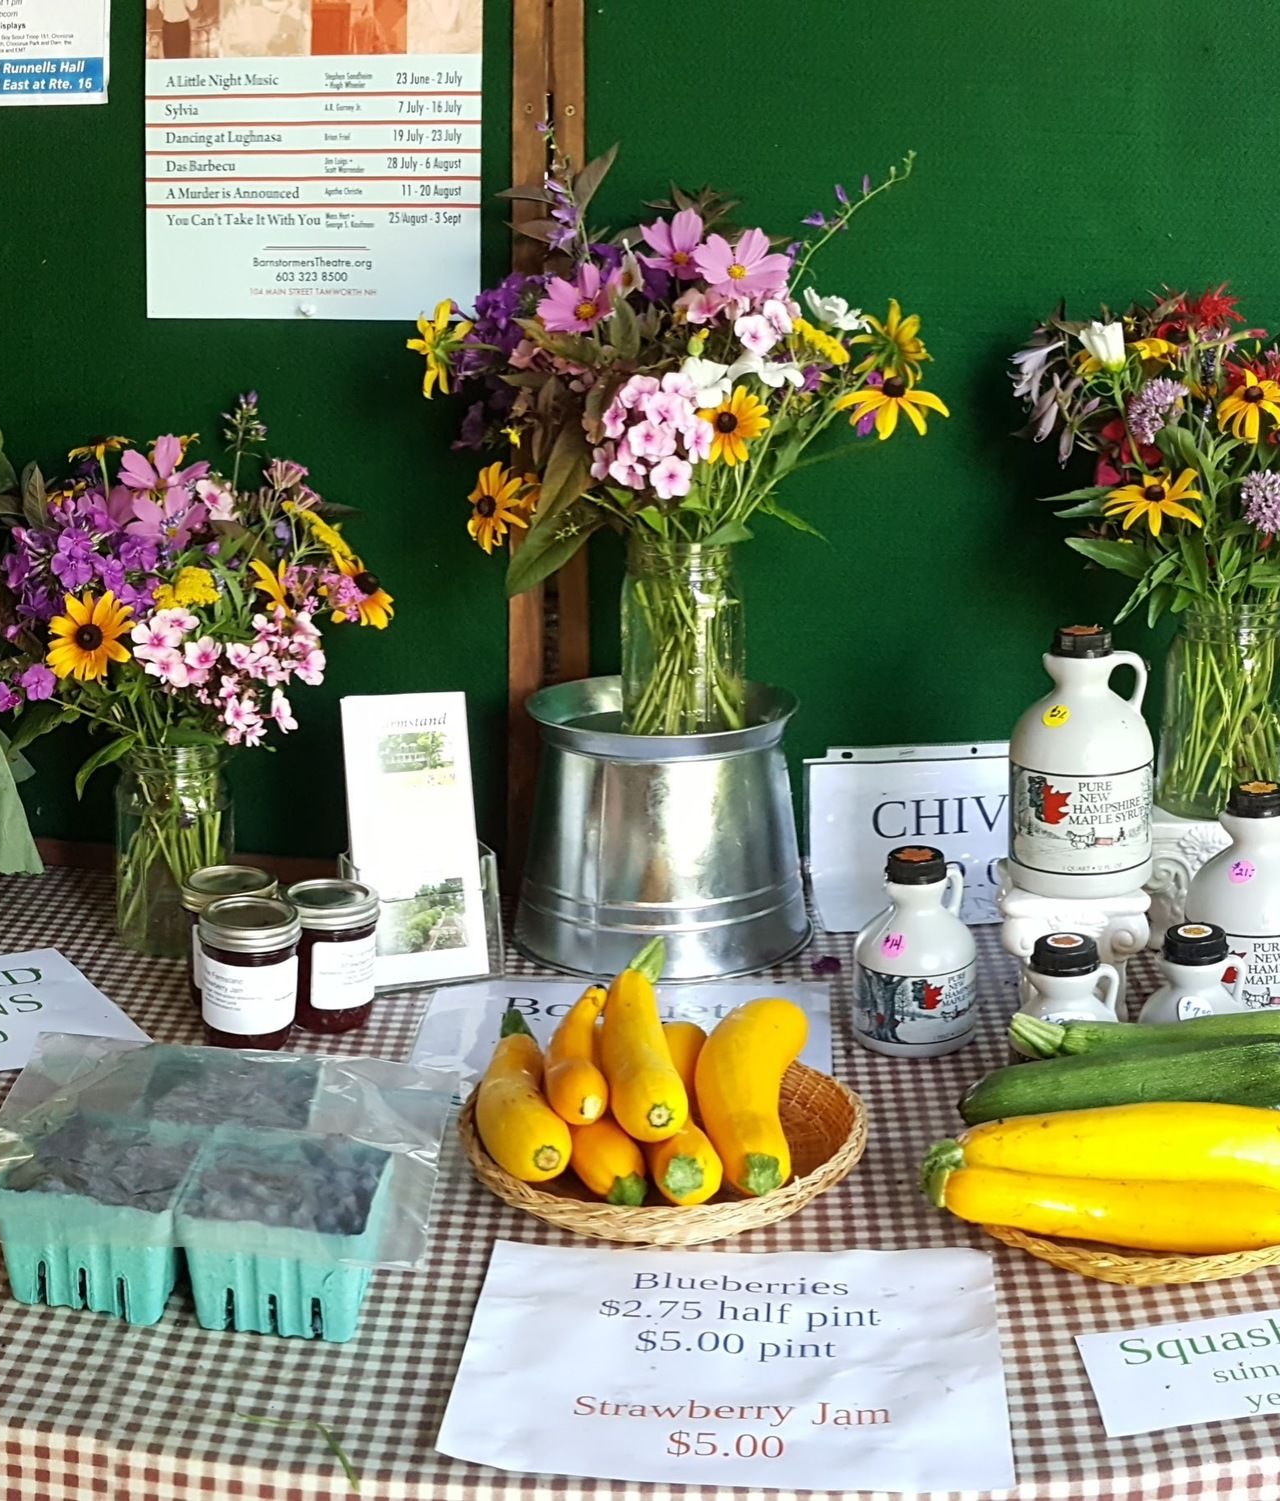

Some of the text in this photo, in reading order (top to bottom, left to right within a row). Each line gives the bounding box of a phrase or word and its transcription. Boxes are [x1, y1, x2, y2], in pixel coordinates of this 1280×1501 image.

[3, 61, 57, 74] Runnells
[60, 61, 86, 73] Hall
[3, 79, 30, 91] East
[49, 78, 73, 90] Rte.
[208, 74, 280, 90] Night Music
[165, 104, 199, 118] Sylvia
[165, 131, 283, 147] Dancing Lughnasa
[166, 160, 189, 172] Das
[177, 184, 462, 199] Murder Announced August
[166, 214, 189, 226] You
[225, 213, 254, 226] Take
[267, 213, 296, 226] With
[298, 213, 322, 226] You
[252, 257, 373, 270] BarnstormersTheatre.org
[321, 271, 348, 282] 8500
[1078, 781, 1113, 793] PURE
[1072, 796, 1141, 815] HAMPSHIRE
[1080, 793, 1111, 804] NEW
[872, 795, 1009, 839] CHIV
[1068, 815, 1113, 826] MAPLE
[632, 1272, 850, 1297] Blueberries
[598, 1298, 879, 1333] $2.75 half pint
[635, 1330, 838, 1362] $5.00 pint
[573, 1395, 892, 1427] Strawberry Jam
[666, 1429, 786, 1460] $5.00
